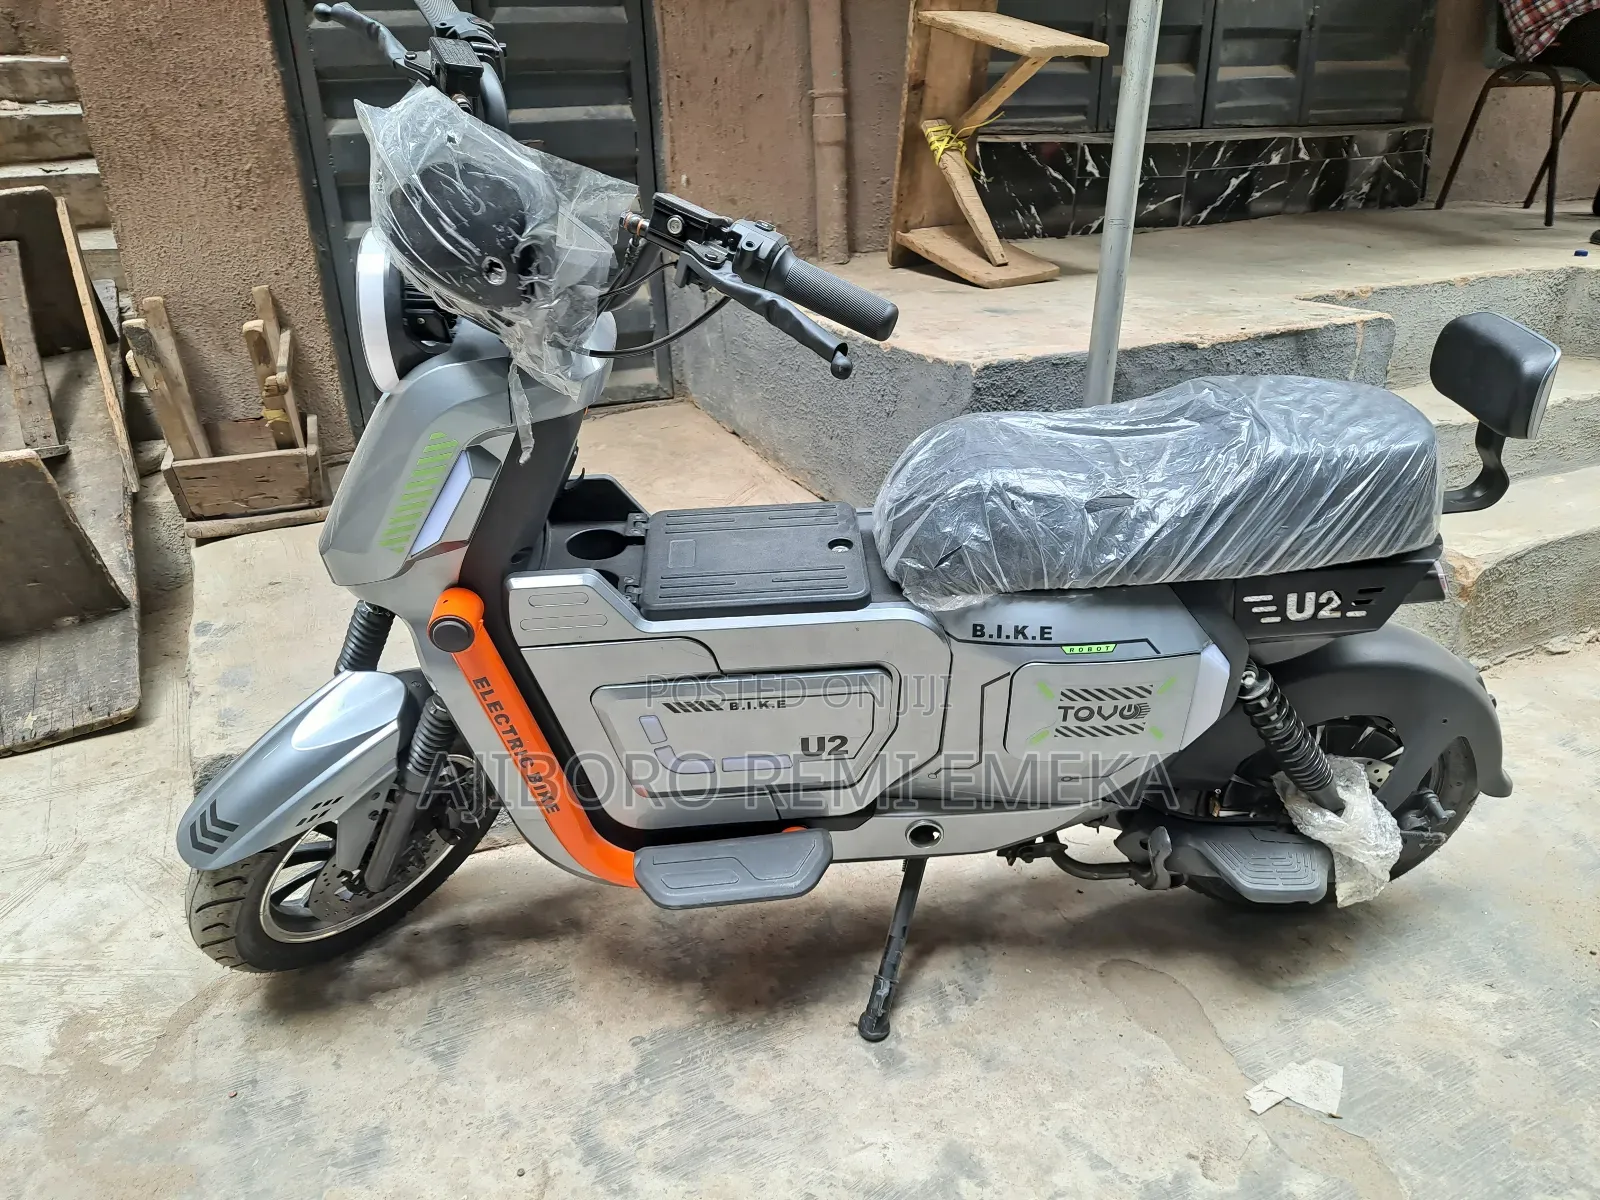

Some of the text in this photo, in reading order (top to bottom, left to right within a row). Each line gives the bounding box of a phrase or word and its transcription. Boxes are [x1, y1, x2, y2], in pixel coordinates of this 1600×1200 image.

[1286, 590, 1342, 621] U2
[972, 623, 1053, 641] B.I.K.E
[1069, 645, 1112, 653] ROBOT
[729, 700, 787, 712] B.I.K.E
[472, 676, 561, 814] ELECTRIC BIKE
[800, 735, 849, 757] U2
